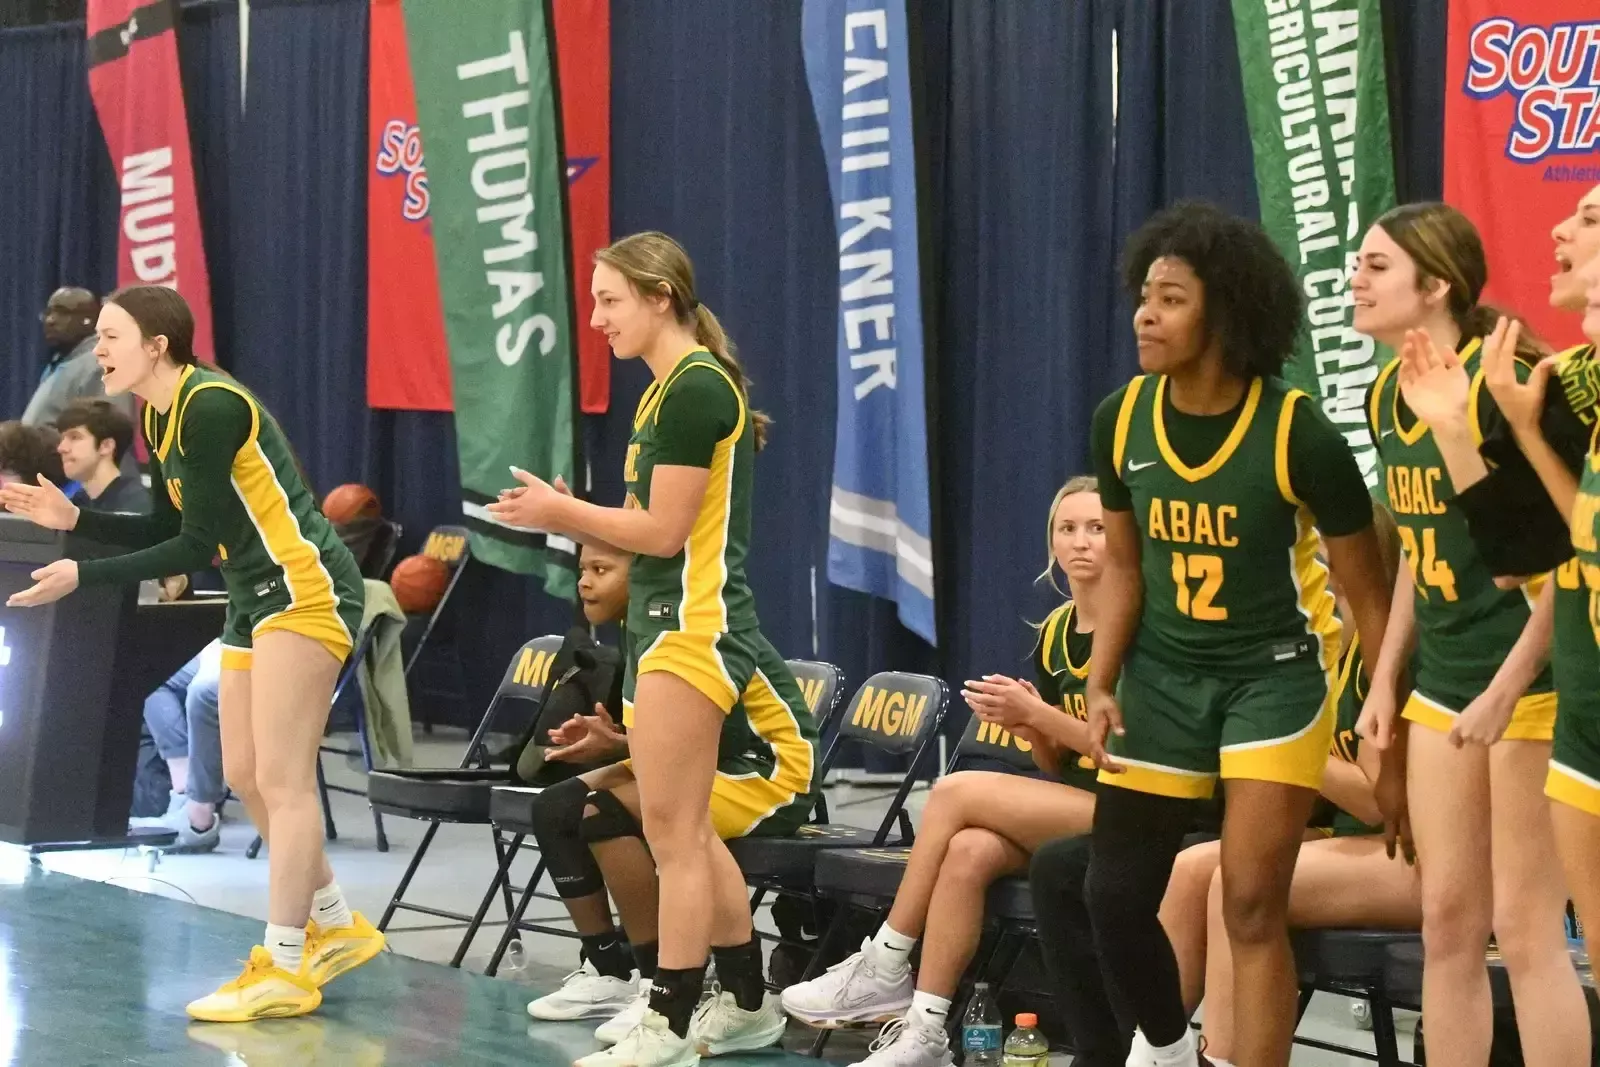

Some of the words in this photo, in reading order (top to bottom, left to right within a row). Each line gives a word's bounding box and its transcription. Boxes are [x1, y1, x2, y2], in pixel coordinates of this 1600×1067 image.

[456, 30, 556, 366] THOMAS
[1387, 465, 1447, 515] ABAC
[1149, 497, 1239, 548] ABAC
[1172, 551, 1228, 621] 12
[852, 685, 927, 736] MGM
